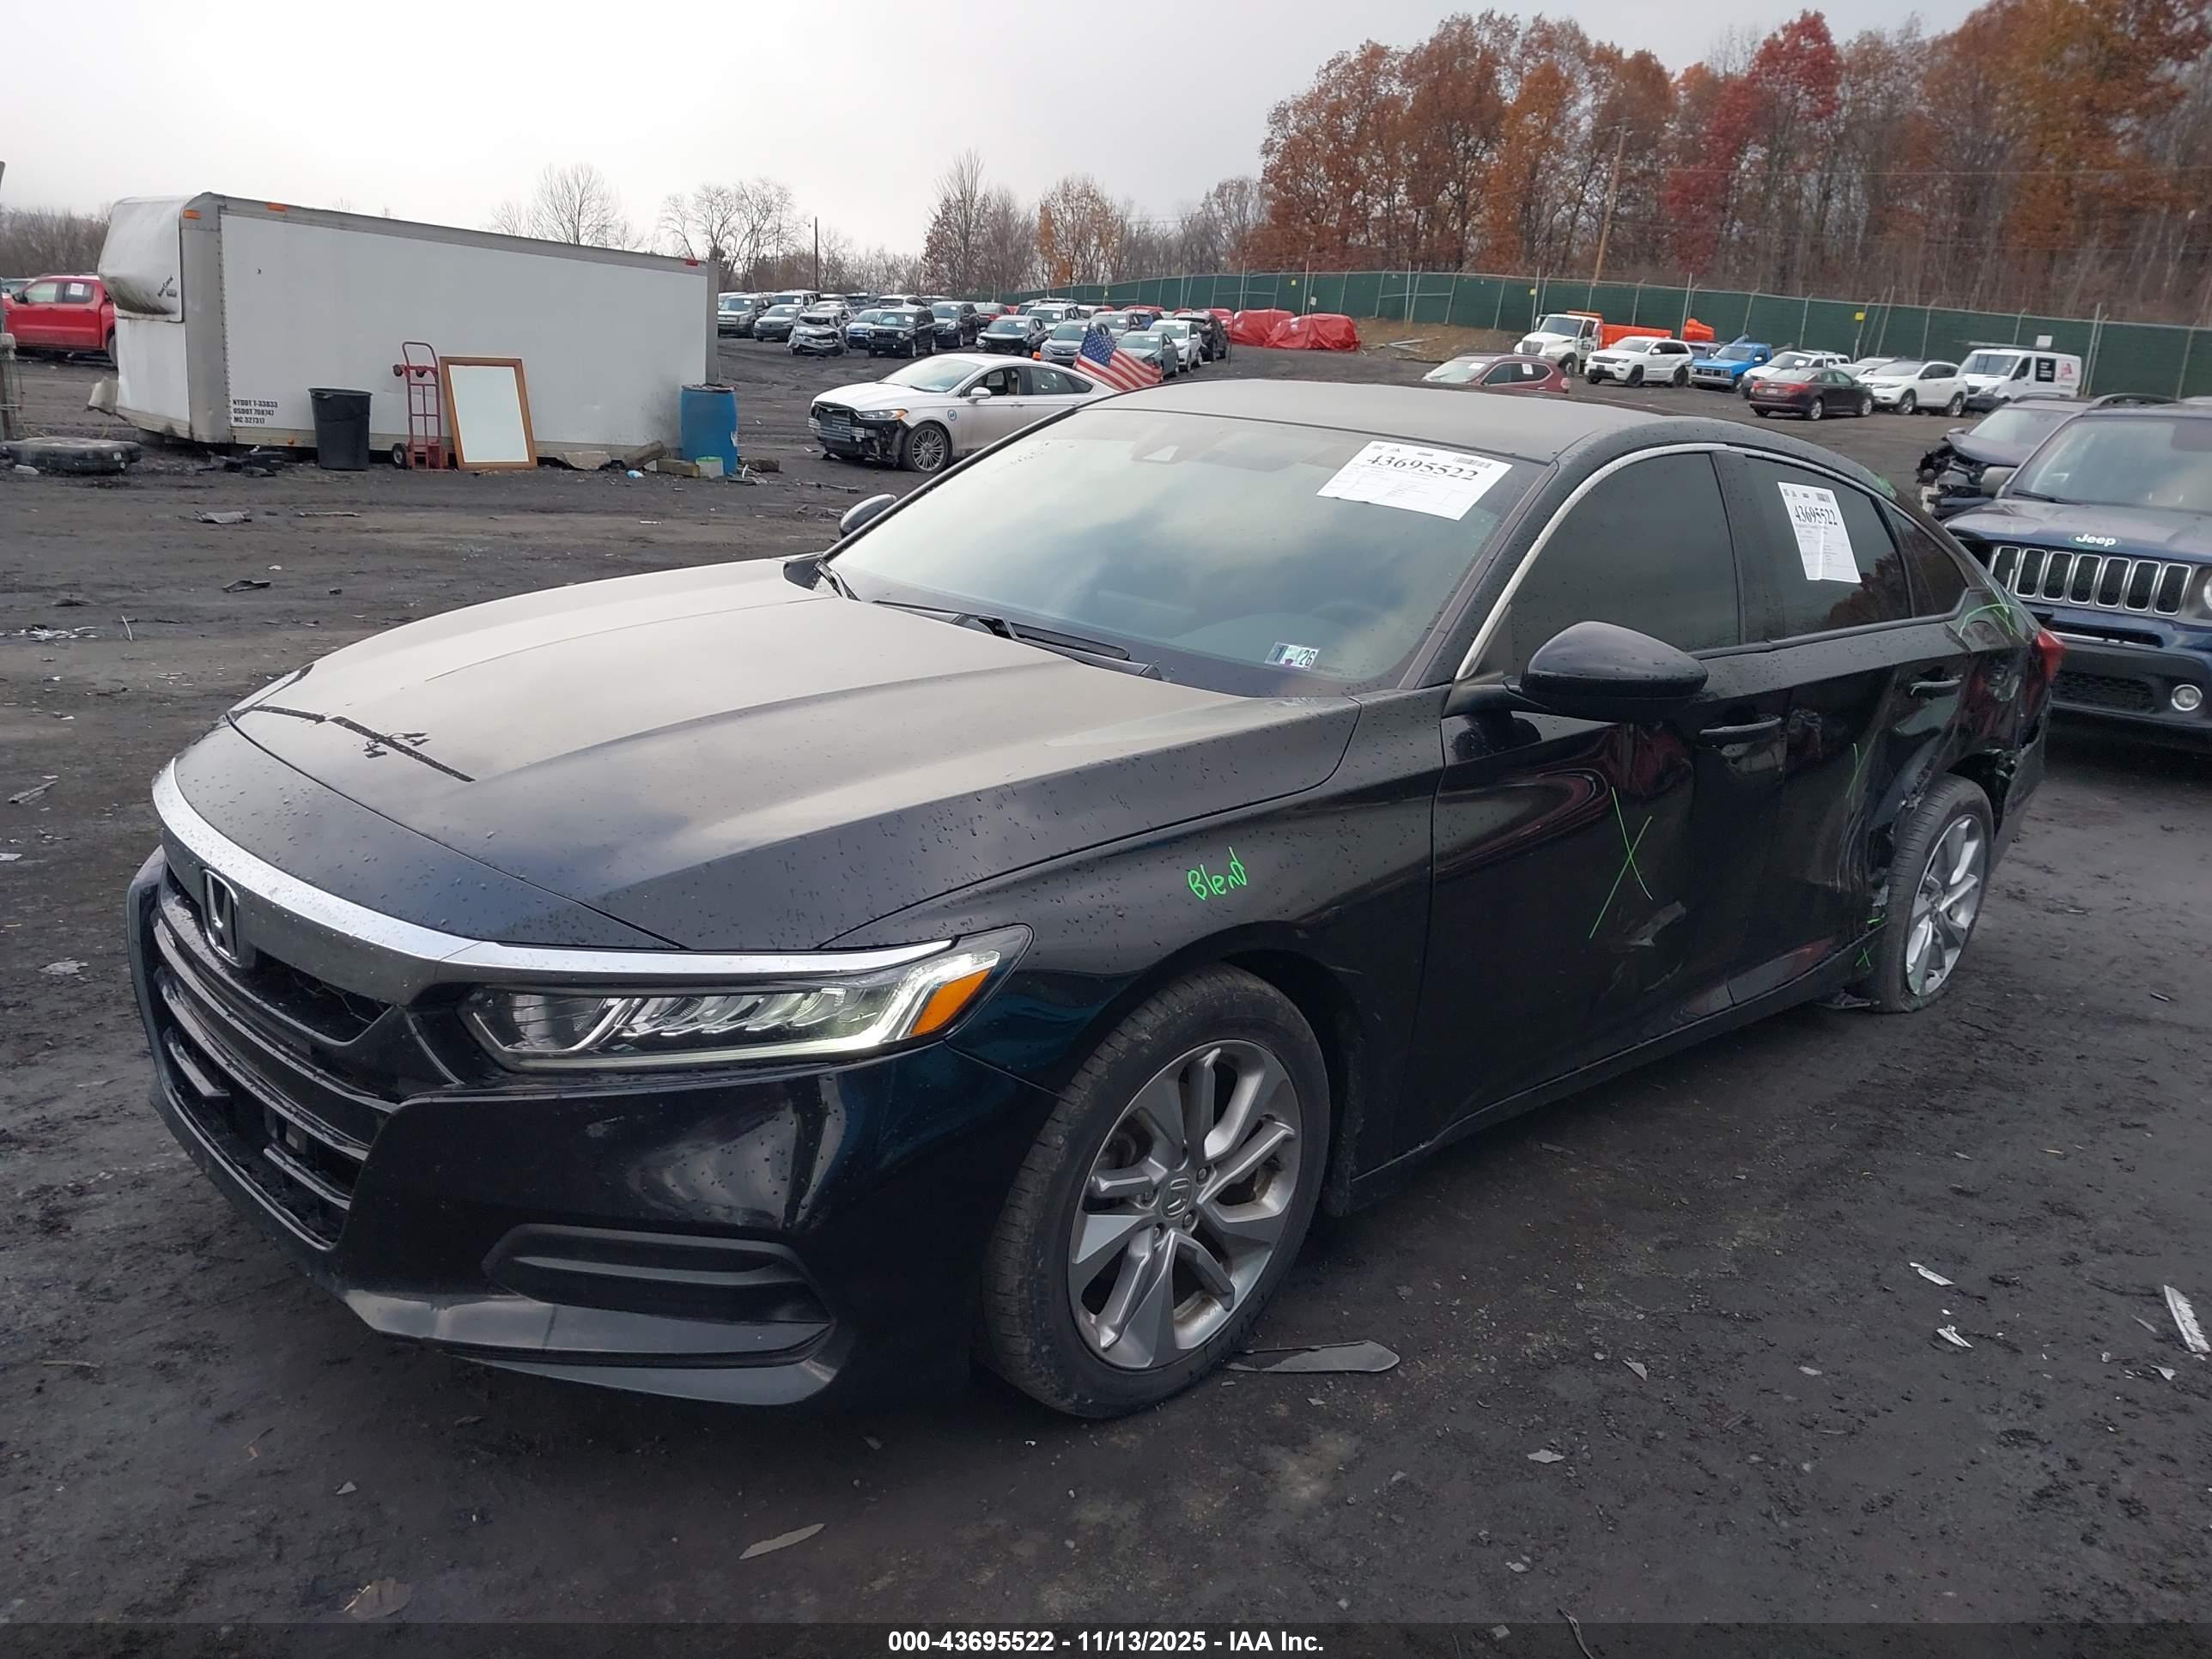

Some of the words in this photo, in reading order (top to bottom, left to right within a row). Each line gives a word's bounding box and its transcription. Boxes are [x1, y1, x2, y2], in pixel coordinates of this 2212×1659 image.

[1366, 454, 1480, 481] 43695522
[1794, 504, 1838, 526] 43695522
[2075, 533, 2117, 547] Jeep
